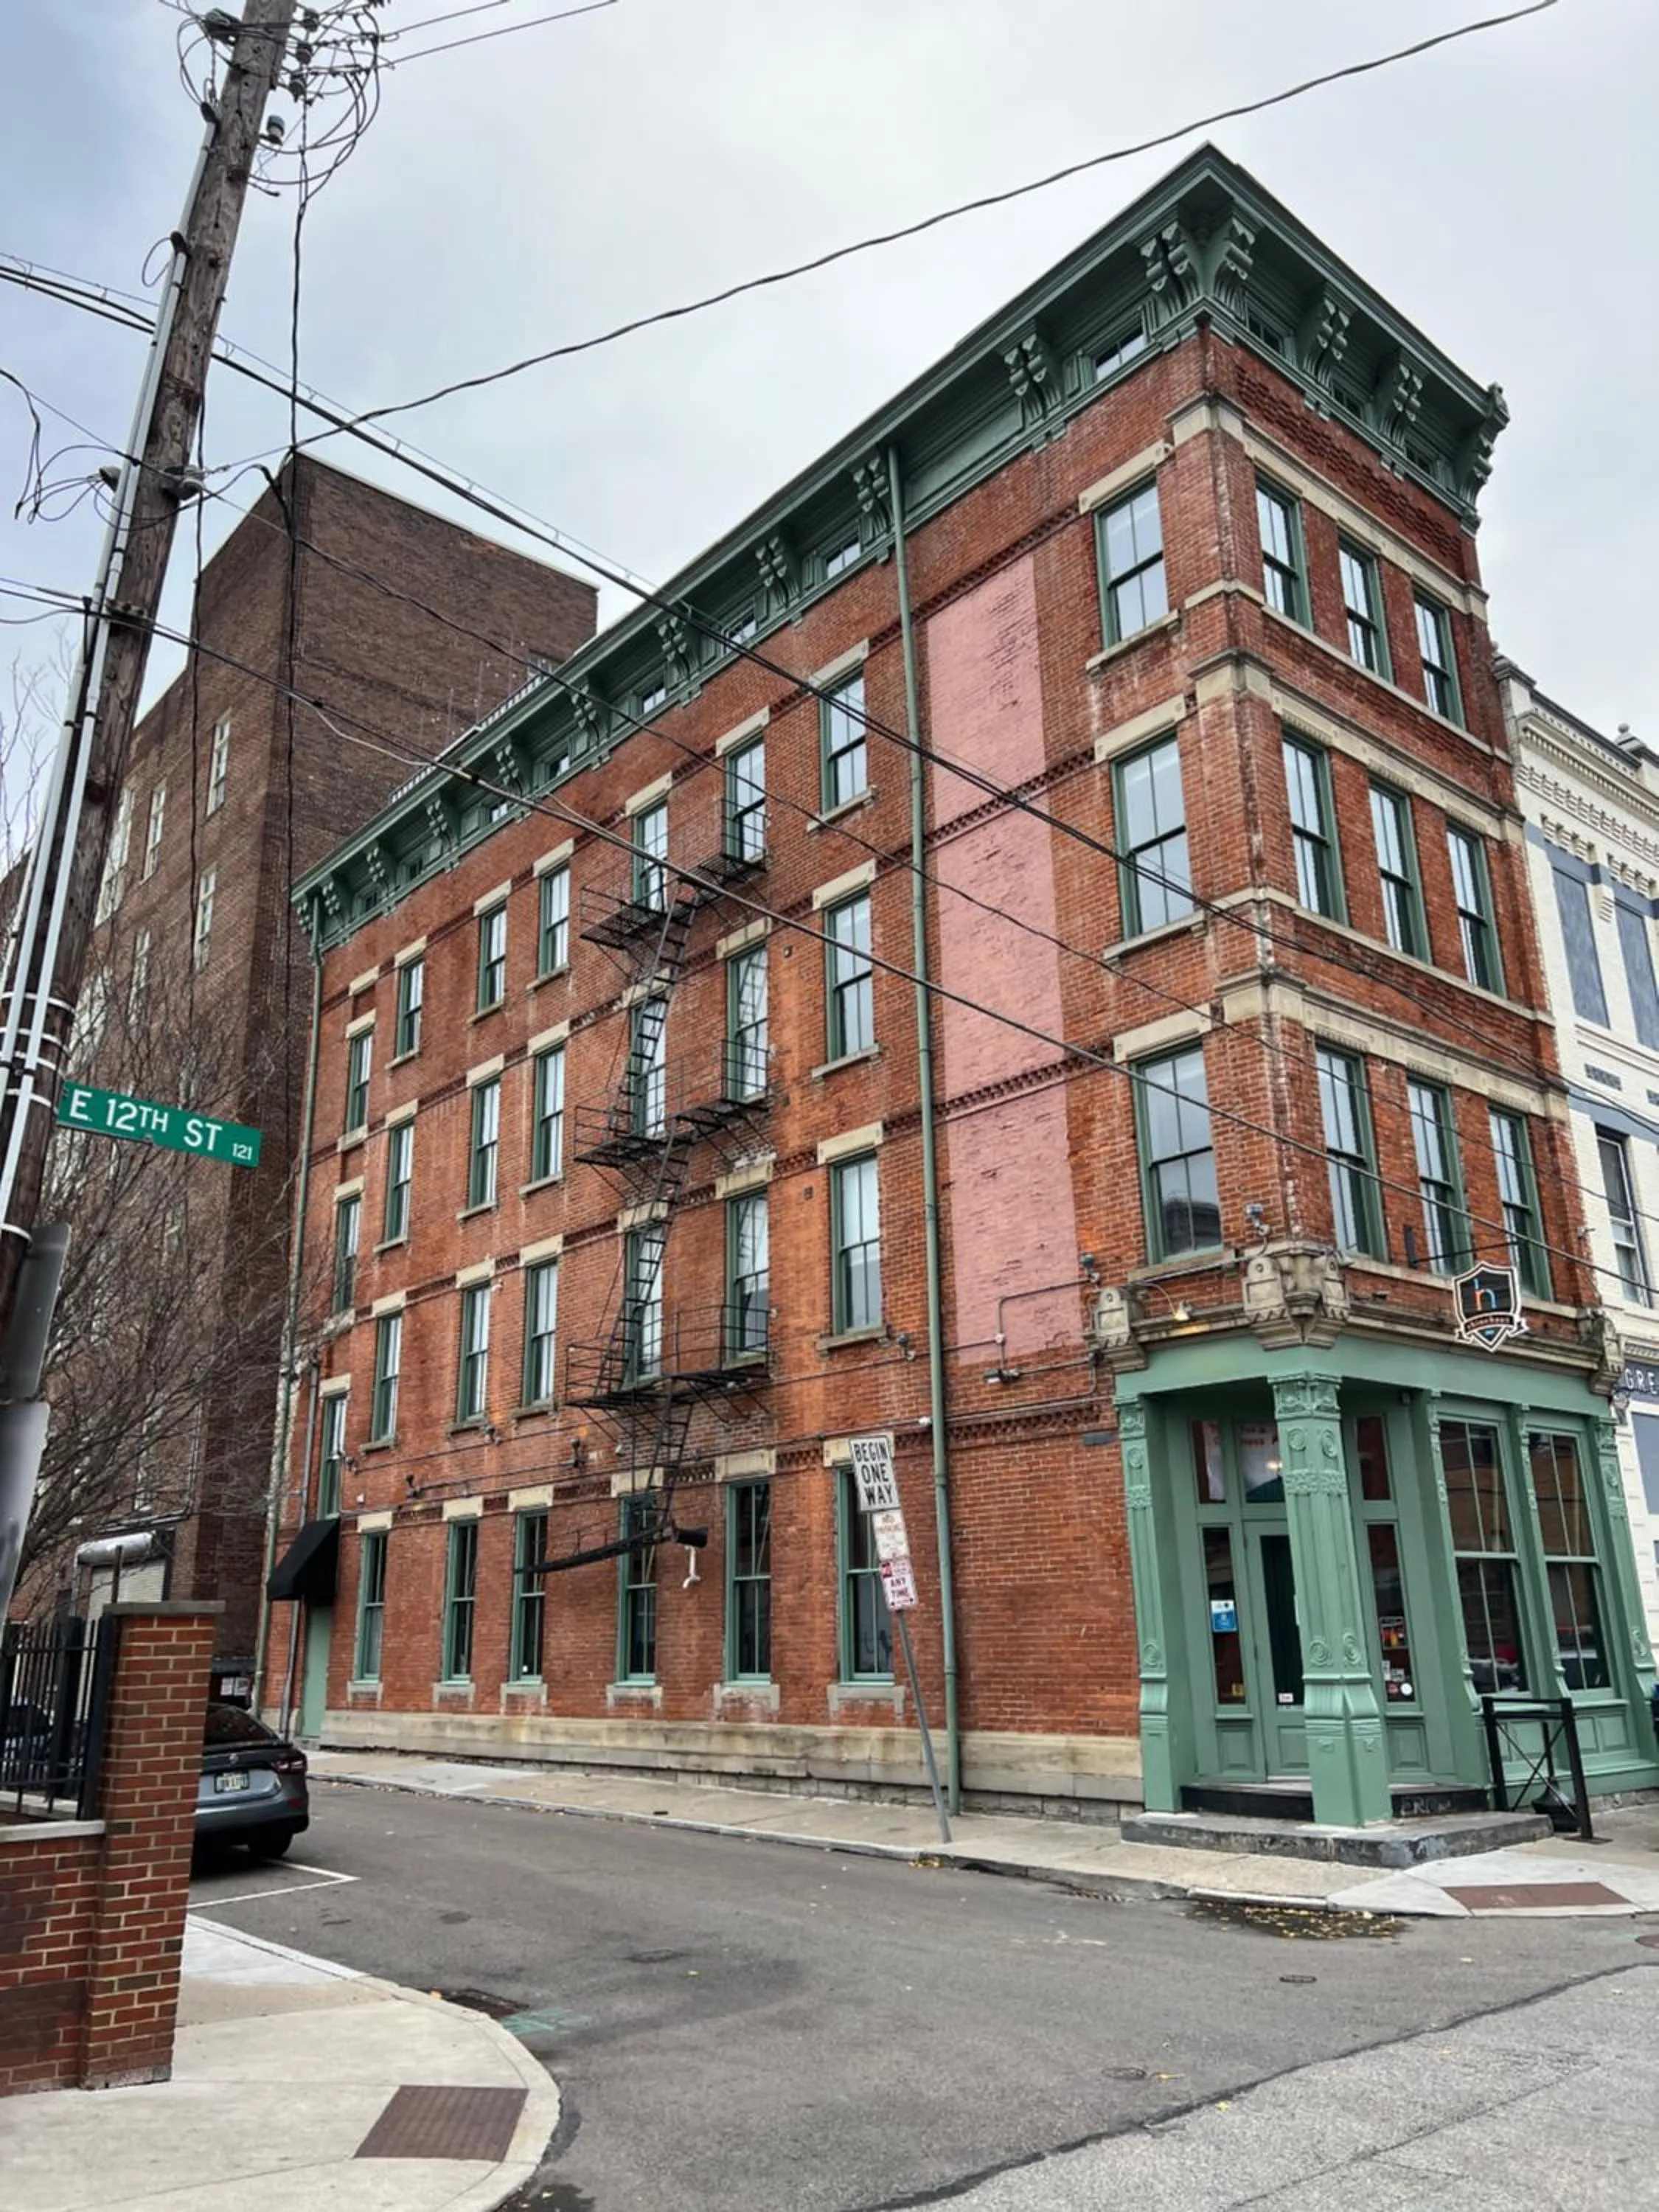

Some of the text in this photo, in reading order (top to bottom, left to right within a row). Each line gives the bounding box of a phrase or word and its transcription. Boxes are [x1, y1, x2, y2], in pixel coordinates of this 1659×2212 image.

[69, 1089, 253, 1160] E 12TH ST 121
[854, 1441, 888, 1462] BEGIN
[861, 1462, 889, 1484] ONE
[864, 1484, 893, 1506] WAY
